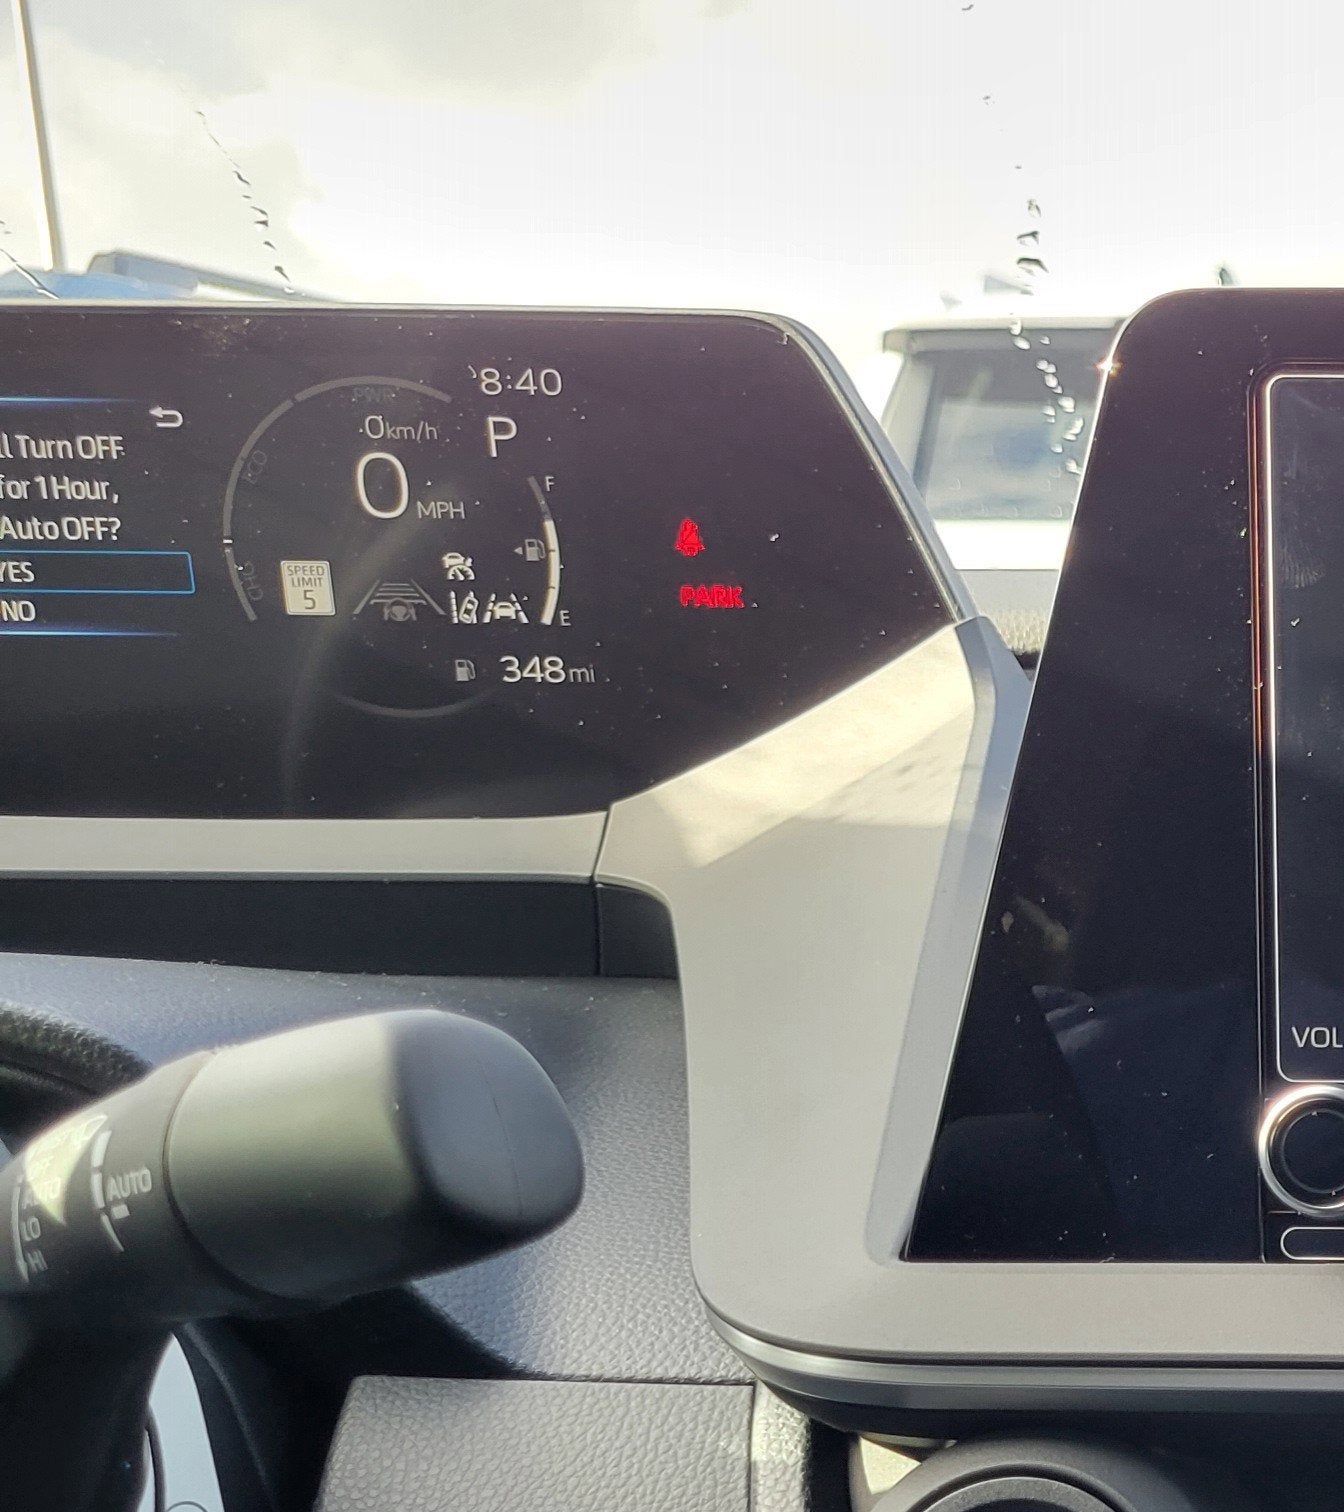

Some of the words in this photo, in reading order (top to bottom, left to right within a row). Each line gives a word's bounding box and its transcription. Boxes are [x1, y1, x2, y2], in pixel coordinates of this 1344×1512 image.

[480, 368, 562, 396] 8:40
[15, 434, 73, 459] Turn
[75, 435, 123, 460] OFF
[487, 415, 518, 458] P
[33, 475, 48, 500] 1
[50, 475, 119, 504] Hour,
[357, 451, 410, 519] 0
[417, 501, 466, 520] MPH
[545, 475, 555, 492] F
[0, 515, 60, 540] Auto
[61, 515, 122, 541] OFF?
[286, 565, 325, 577] SPEED
[291, 576, 324, 588] LIMIT
[303, 589, 317, 610] 5
[679, 584, 745, 609] PARK
[0, 600, 36, 622] NO
[559, 609, 571, 627] E
[1291, 1026, 1344, 1048] VOL
[106, 1166, 153, 1201] AUTO
[19, 1216, 41, 1242] LO
[25, 1250, 49, 1273] HI
